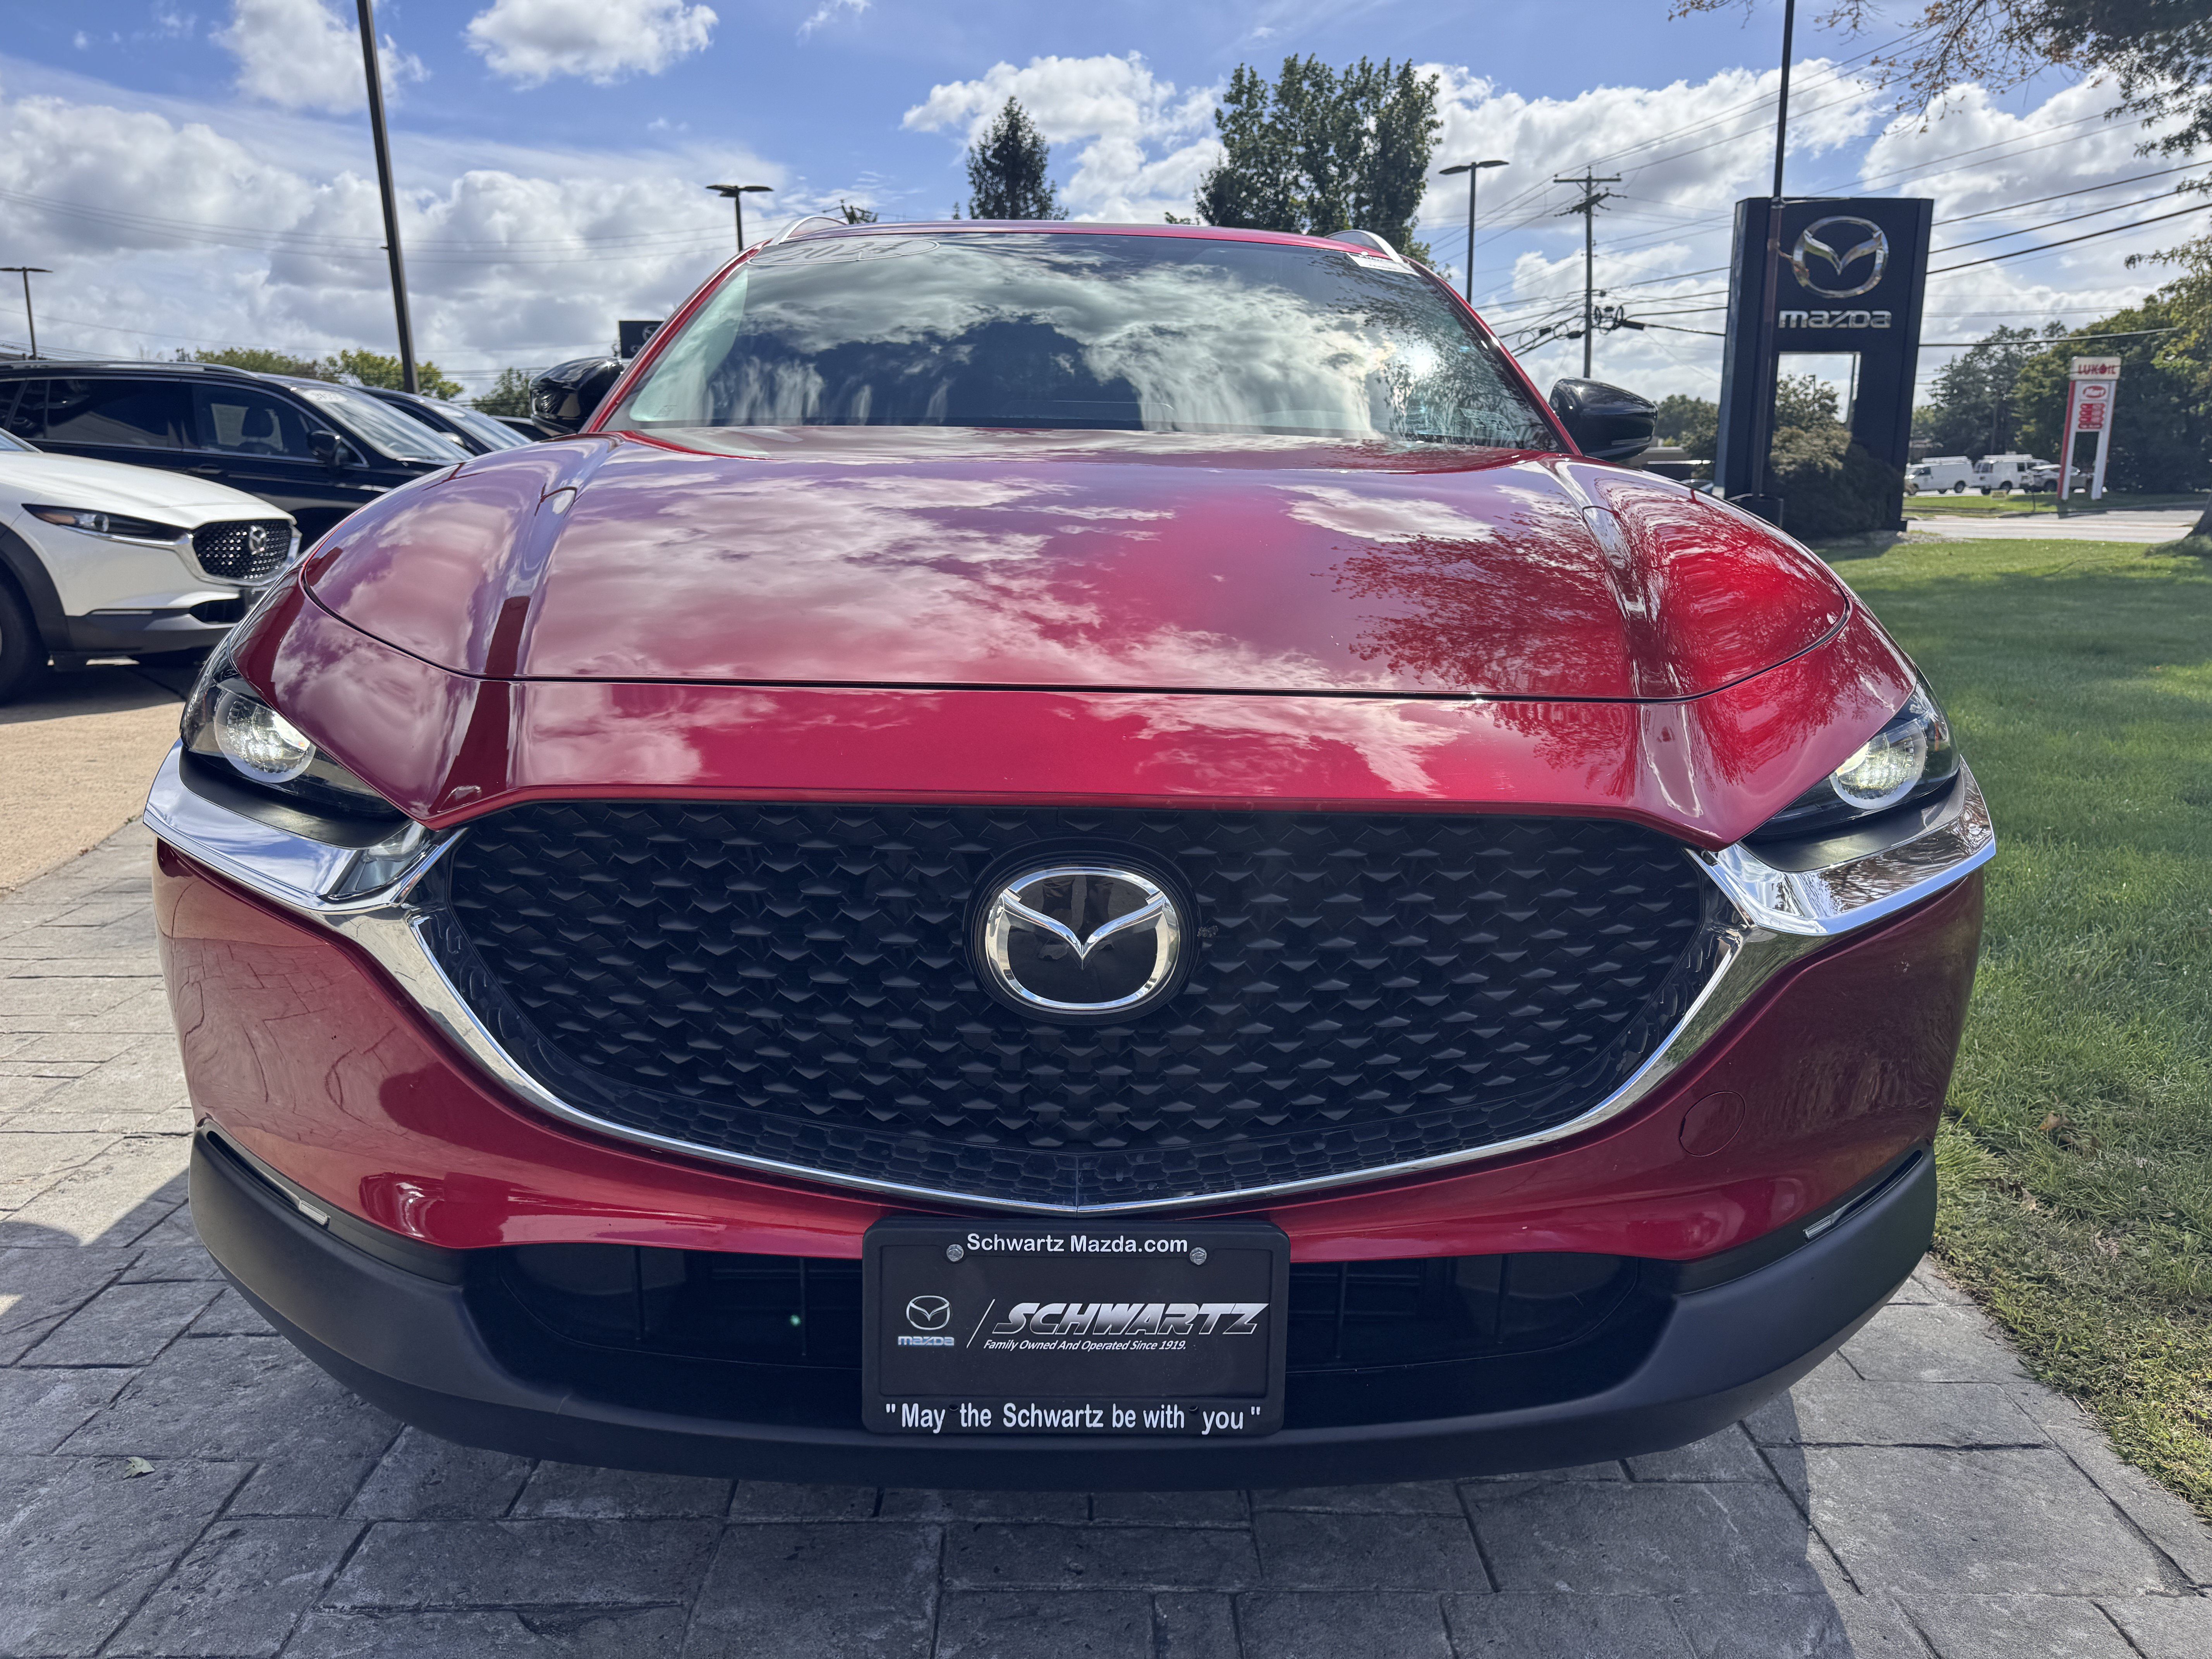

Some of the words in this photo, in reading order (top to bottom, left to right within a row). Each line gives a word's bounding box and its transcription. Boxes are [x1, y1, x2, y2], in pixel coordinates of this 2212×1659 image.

[967, 1233, 1064, 1252] Schwartz
[1070, 1235, 1188, 1252] Mazda.com
[992, 1303, 1269, 1334] SCHWARTZ
[984, 1340, 1018, 1352] Family
[1019, 1340, 1058, 1350] Owned
[1057, 1340, 1082, 1350] And
[1081, 1340, 1131, 1352] Operated
[1130, 1340, 1158, 1350] Since
[1159, 1340, 1186, 1350] 1919.
[960, 1403, 991, 1427] the
[1003, 1403, 1104, 1428] Schwartz
[1112, 1403, 1136, 1428] be
[1143, 1404, 1185, 1429] with
